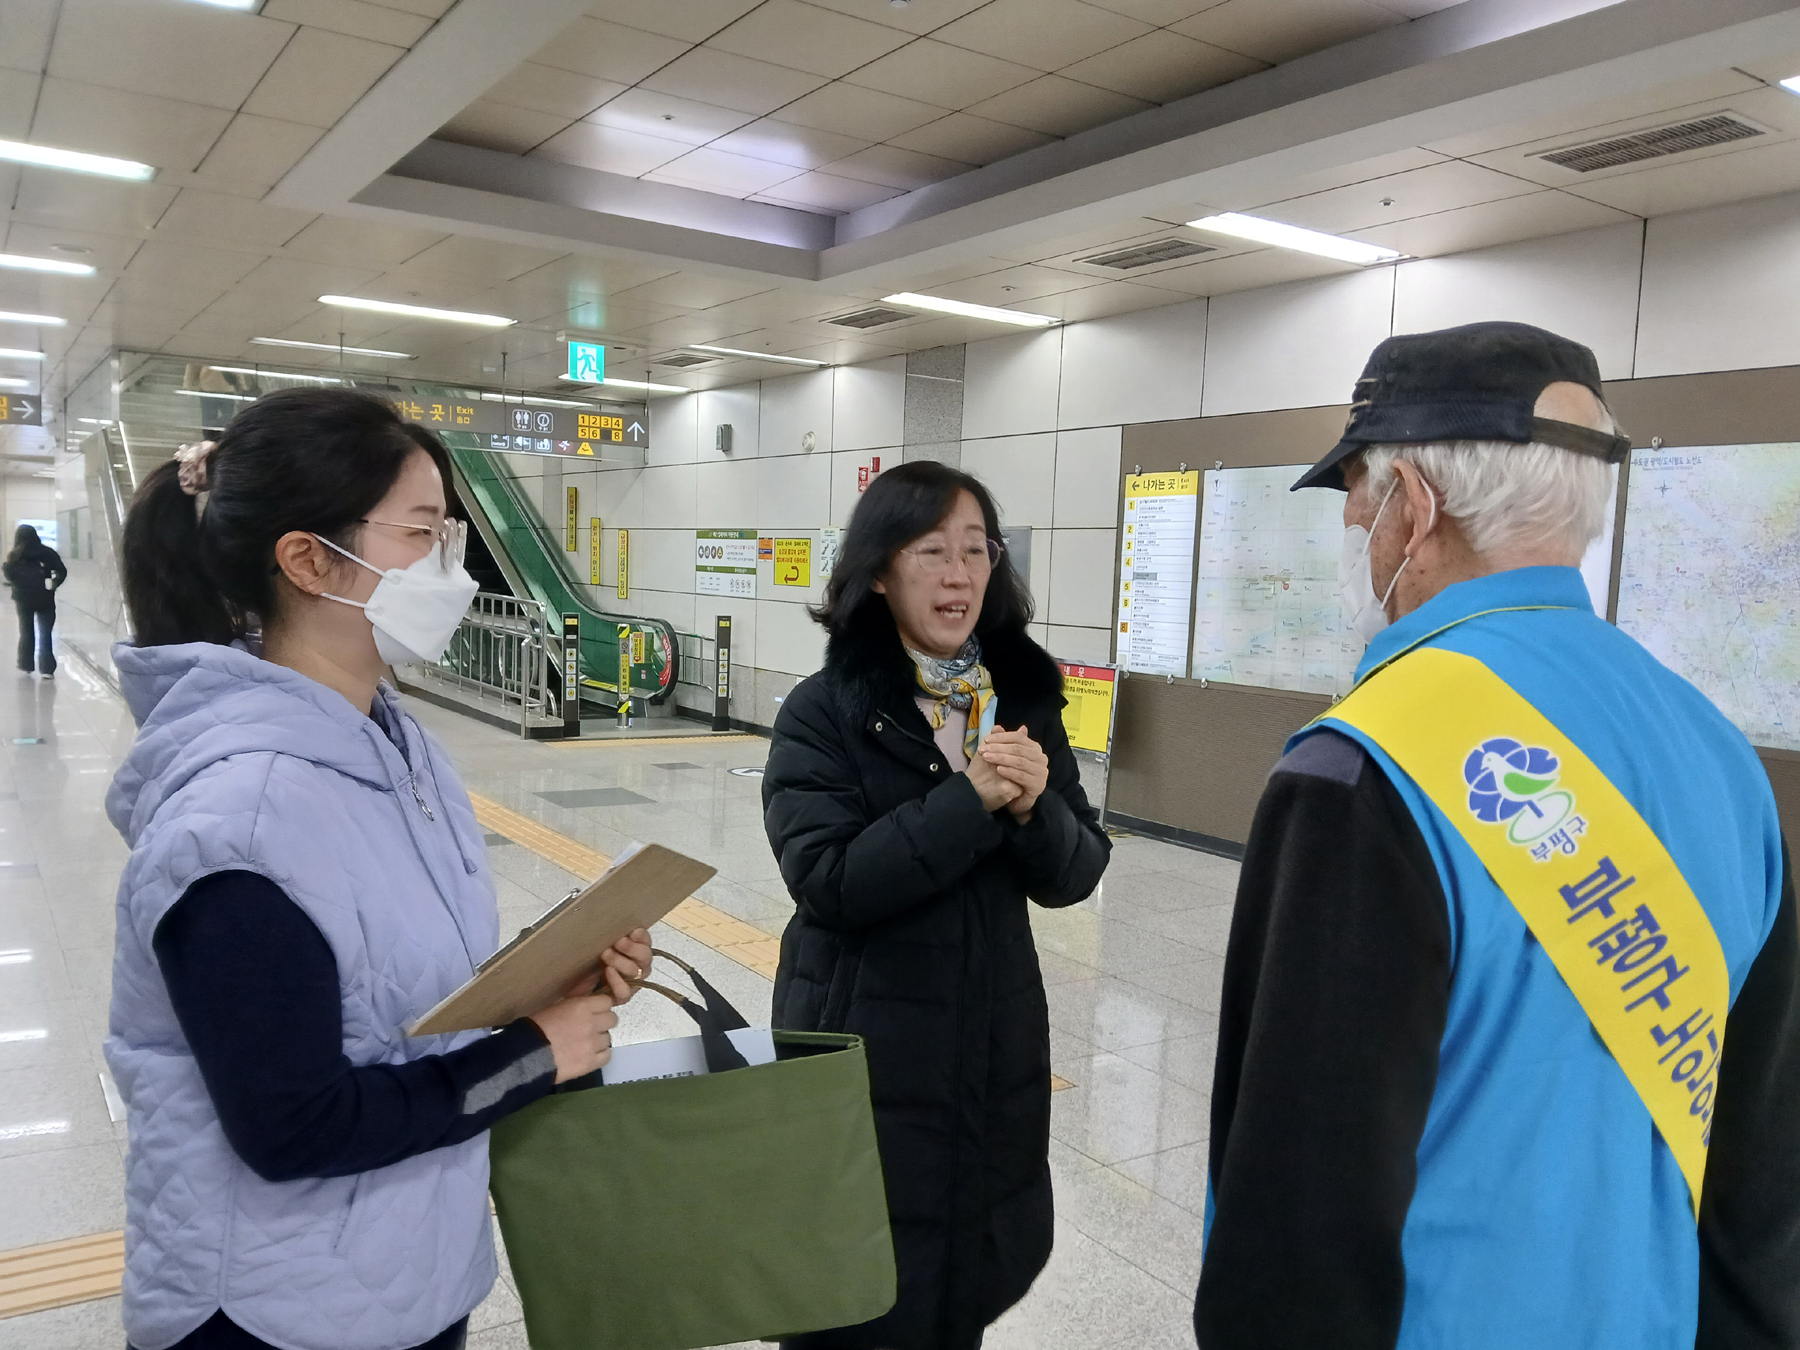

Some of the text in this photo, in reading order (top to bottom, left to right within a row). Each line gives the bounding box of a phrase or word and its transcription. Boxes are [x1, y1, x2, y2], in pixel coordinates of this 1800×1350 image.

[430, 404, 445, 422] 곳
[456, 406, 474, 415] Exit
[1143, 478, 1176, 491] 나가는 곳
[1530, 815, 1587, 861] 부평구
[1558, 855, 1691, 1014] 부평구
